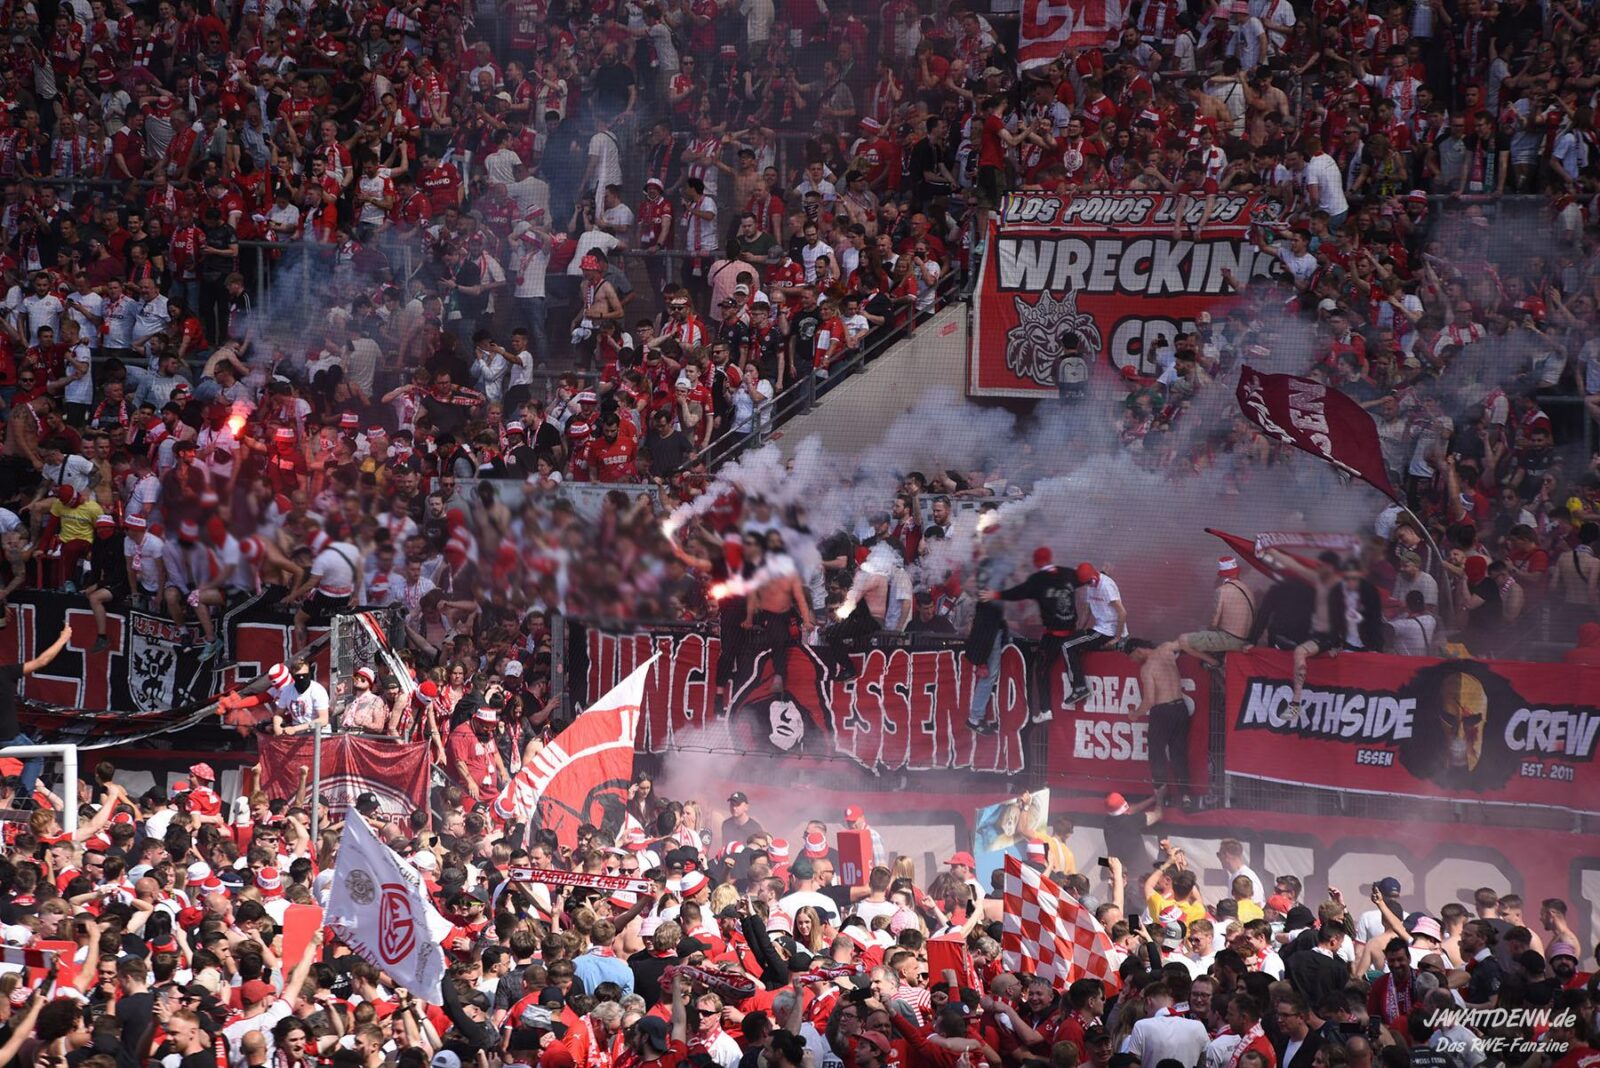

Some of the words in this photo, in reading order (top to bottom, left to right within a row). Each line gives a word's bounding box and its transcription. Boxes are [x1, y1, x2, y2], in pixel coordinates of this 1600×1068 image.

[1006, 197, 1061, 222] LOS
[1243, 683, 1417, 740] NORTHSIDE
[1504, 708, 1600, 756] CREW
[1073, 719, 1151, 761] ESSE
[1357, 750, 1394, 766] ESSEN
[1521, 762, 1547, 778] EST.
[1549, 765, 1575, 781] 2011
[531, 870, 593, 886] NORTHSIDE
[596, 876, 629, 889] CREW
